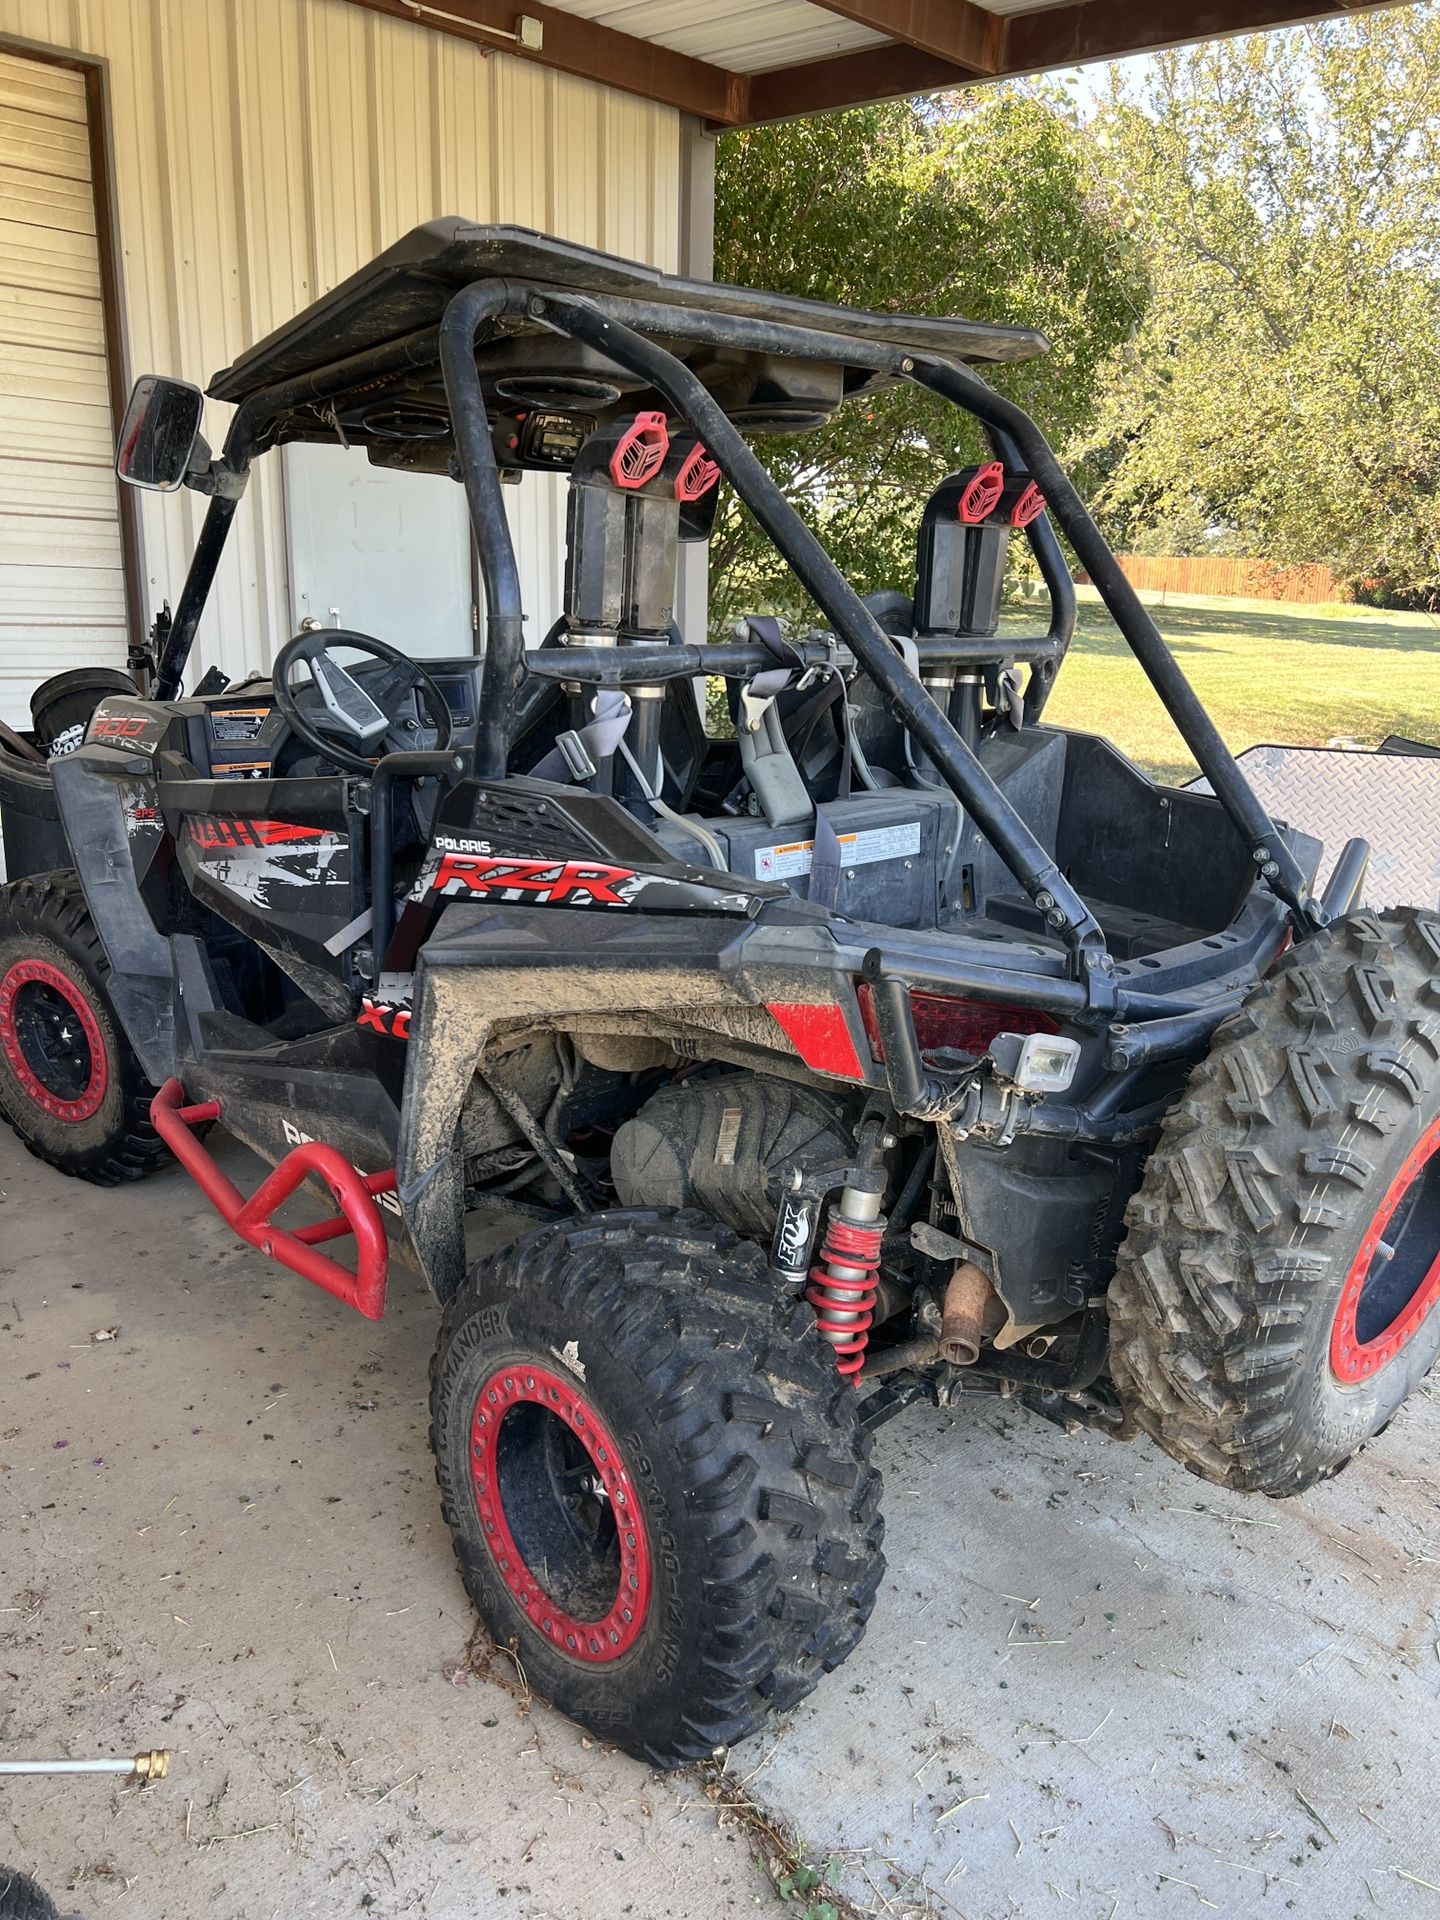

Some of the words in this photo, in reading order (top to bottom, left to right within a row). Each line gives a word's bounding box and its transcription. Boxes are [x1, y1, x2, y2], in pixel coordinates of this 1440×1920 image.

[135, 807, 157, 819] EPS
[436, 837, 491, 853] POLARIS
[433, 852, 636, 903] RZR
[778, 1203, 808, 1266] FOX
[437, 1309, 504, 1450] COMMANDER
